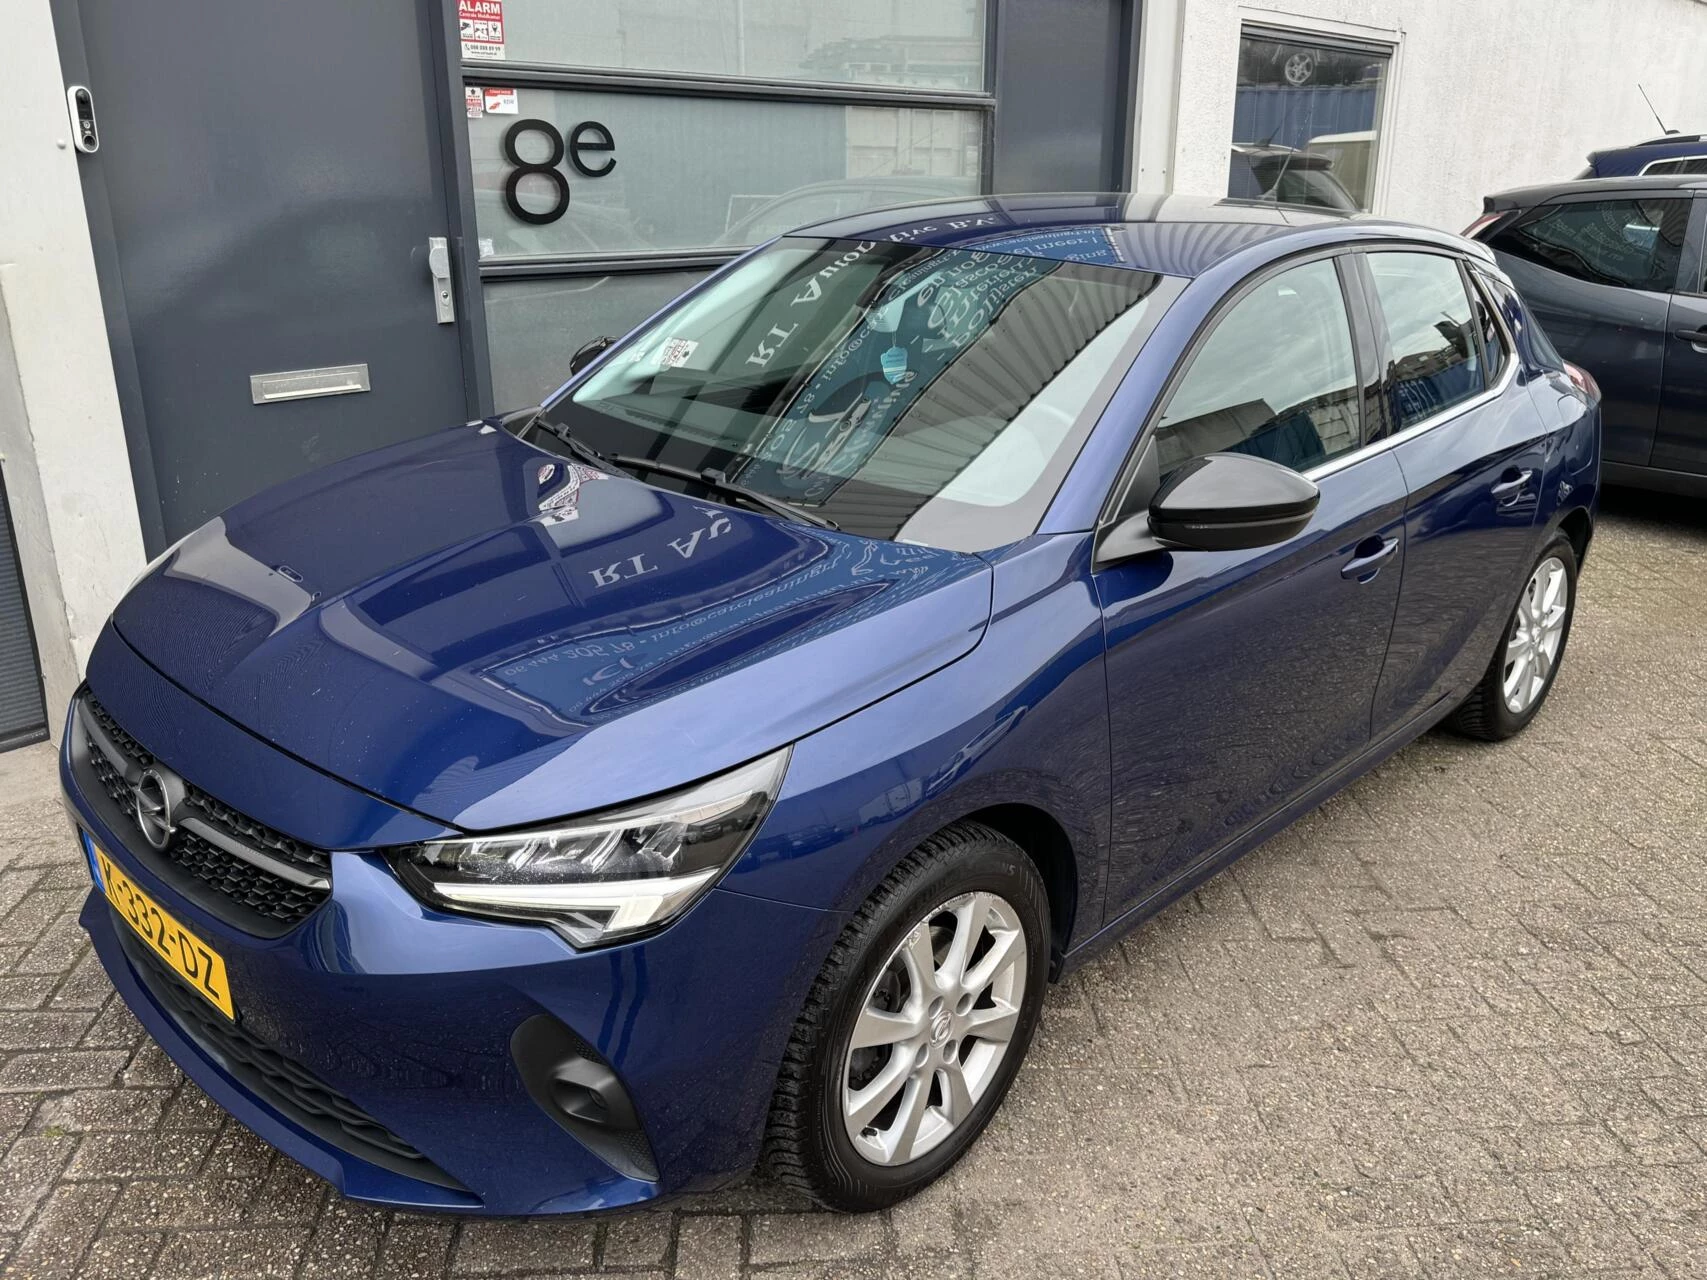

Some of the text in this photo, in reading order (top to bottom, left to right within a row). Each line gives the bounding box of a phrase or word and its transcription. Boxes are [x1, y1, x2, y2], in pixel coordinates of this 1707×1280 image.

[459, 0, 500, 14] ALARM
[505, 119, 617, 225] 8e
[101, 855, 220, 1000] K-332-DZ
